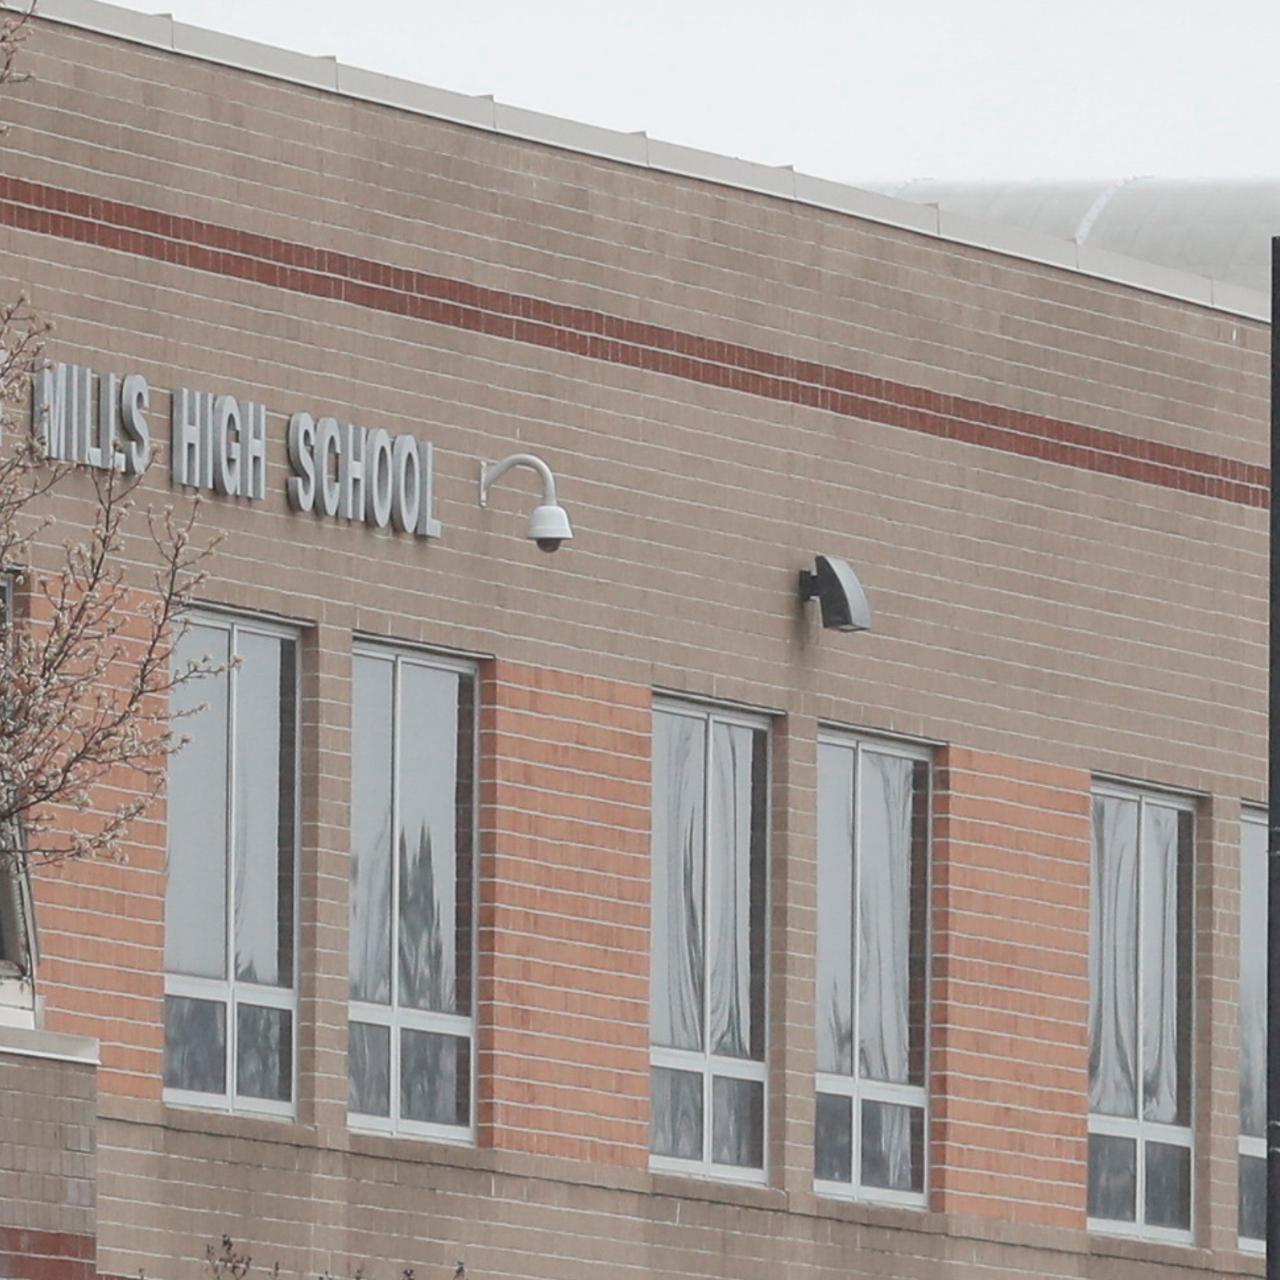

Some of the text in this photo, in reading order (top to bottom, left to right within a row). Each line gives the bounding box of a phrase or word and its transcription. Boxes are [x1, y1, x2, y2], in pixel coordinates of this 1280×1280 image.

[31, 358, 150, 475] MILLS
[172, 386, 266, 500] HIGH
[287, 411, 442, 539] SCHOOL
